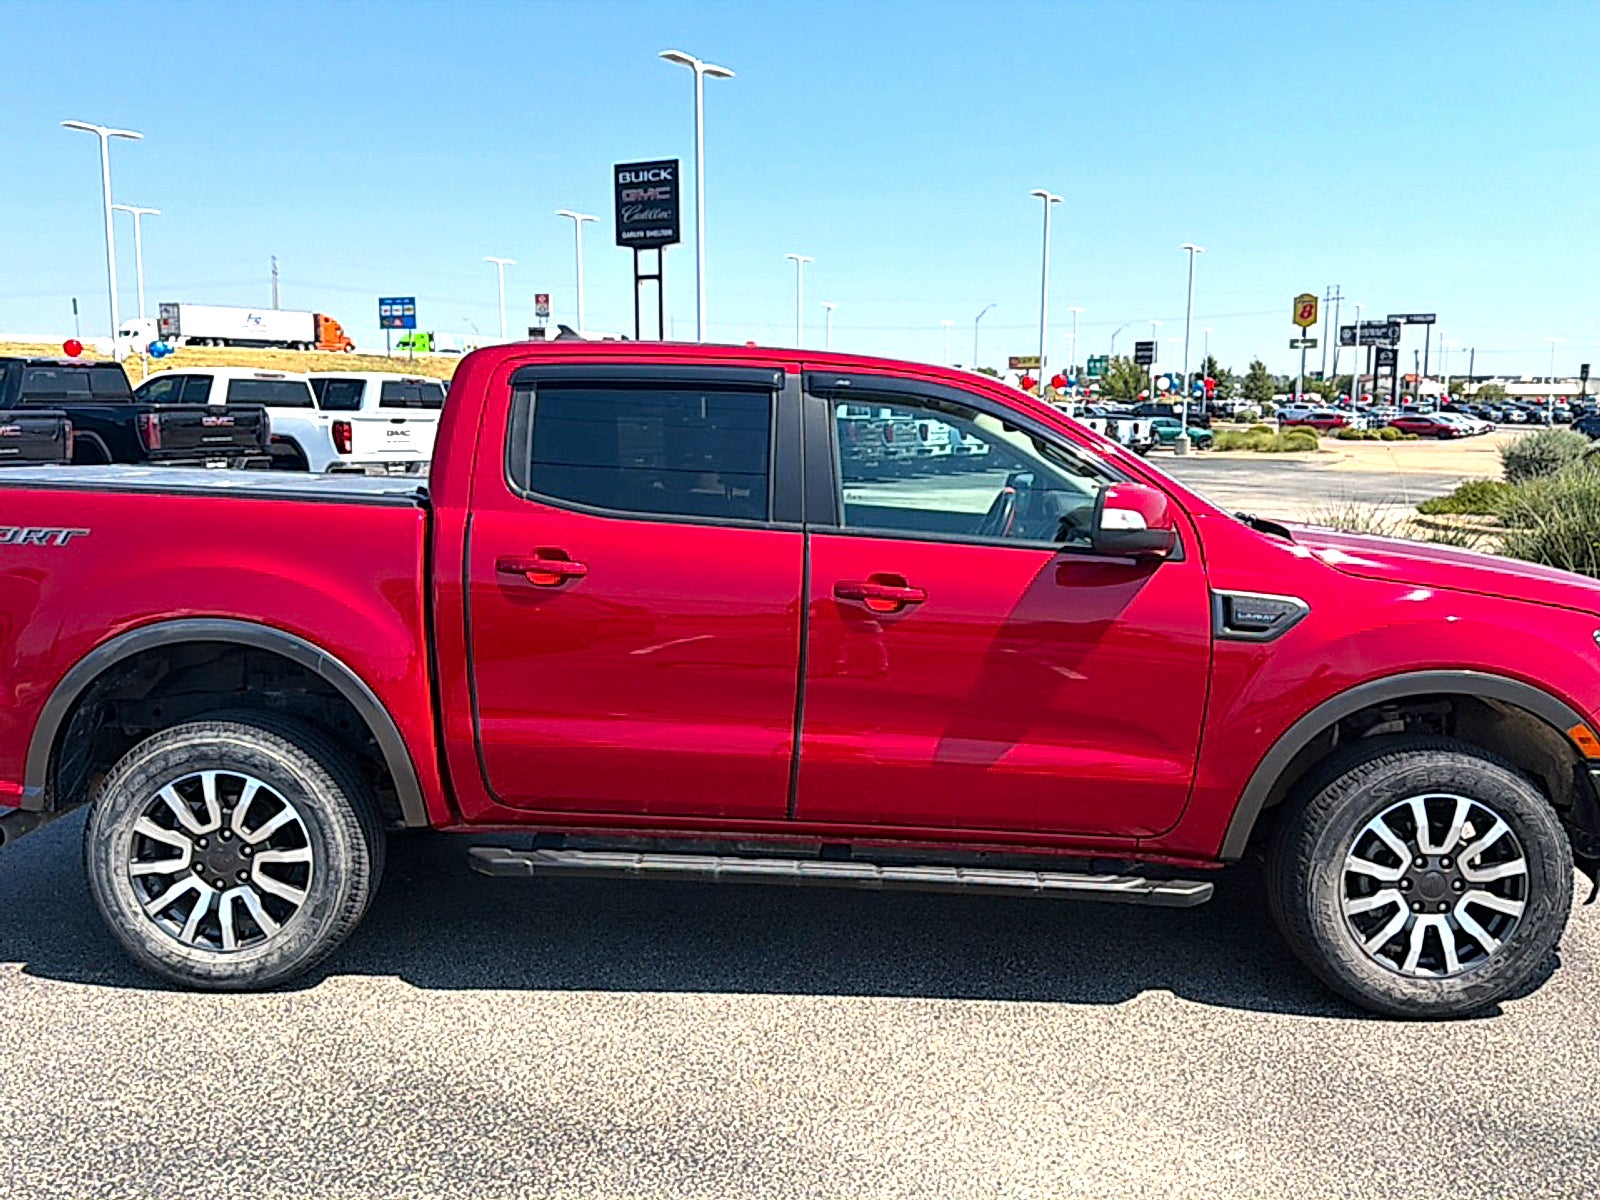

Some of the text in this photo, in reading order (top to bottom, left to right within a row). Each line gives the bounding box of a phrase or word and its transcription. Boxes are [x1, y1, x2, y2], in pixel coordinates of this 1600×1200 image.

[618, 168, 672, 184] BUICK
[621, 186, 671, 202] GMC
[621, 204, 671, 223] Cadillac
[1300, 303, 1314, 320] 8
